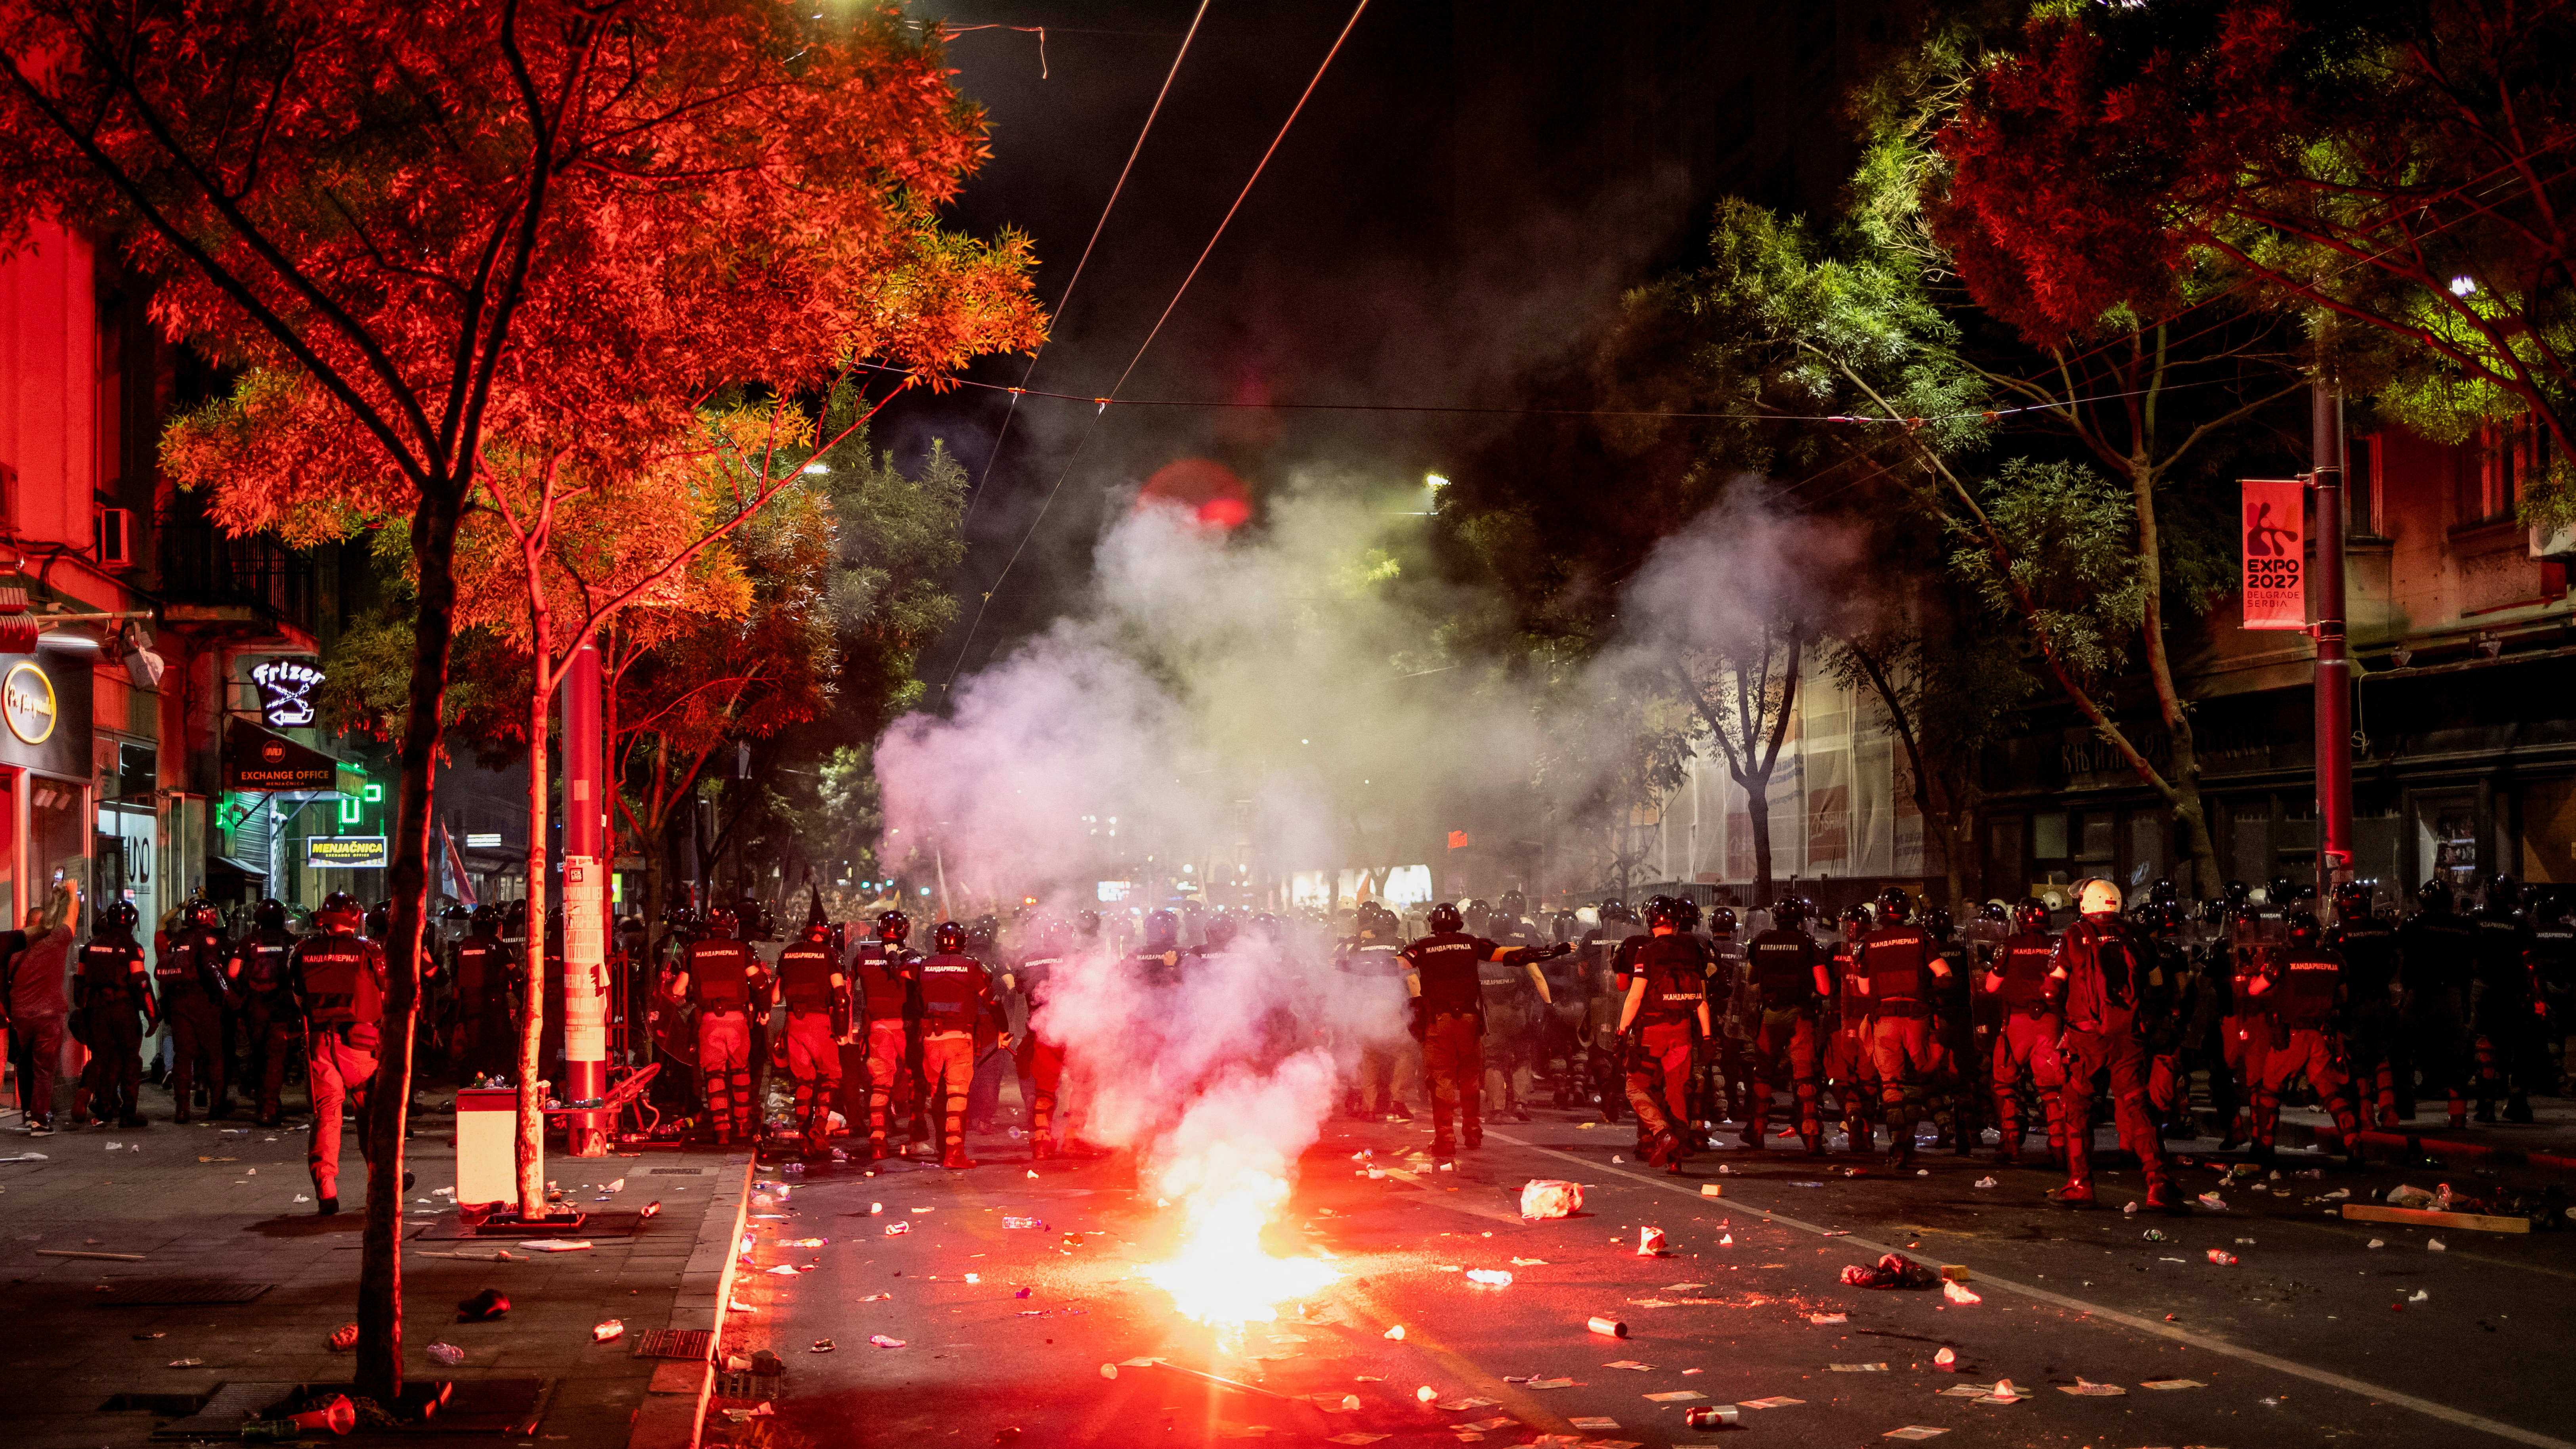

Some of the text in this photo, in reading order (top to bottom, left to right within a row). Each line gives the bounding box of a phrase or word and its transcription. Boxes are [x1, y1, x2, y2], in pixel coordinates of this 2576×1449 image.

[2247, 559, 2299, 573] EXPO
[2247, 574, 2299, 589] 2027
[253, 662, 325, 685] Frizer
[241, 771, 329, 780] EXCHANGE OFFICE
[312, 841, 383, 853] MENJAČNICA
[1870, 938, 1919, 948] ЖАНДАРМЕРИЈА
[1426, 944, 1471, 954] ЖАНДАРМЕРИЈА
[1025, 958, 1063, 967] ЖАНДАРМЕРИЈА
[1663, 992, 1701, 1001] ЖАНДАРМЕРЈА
